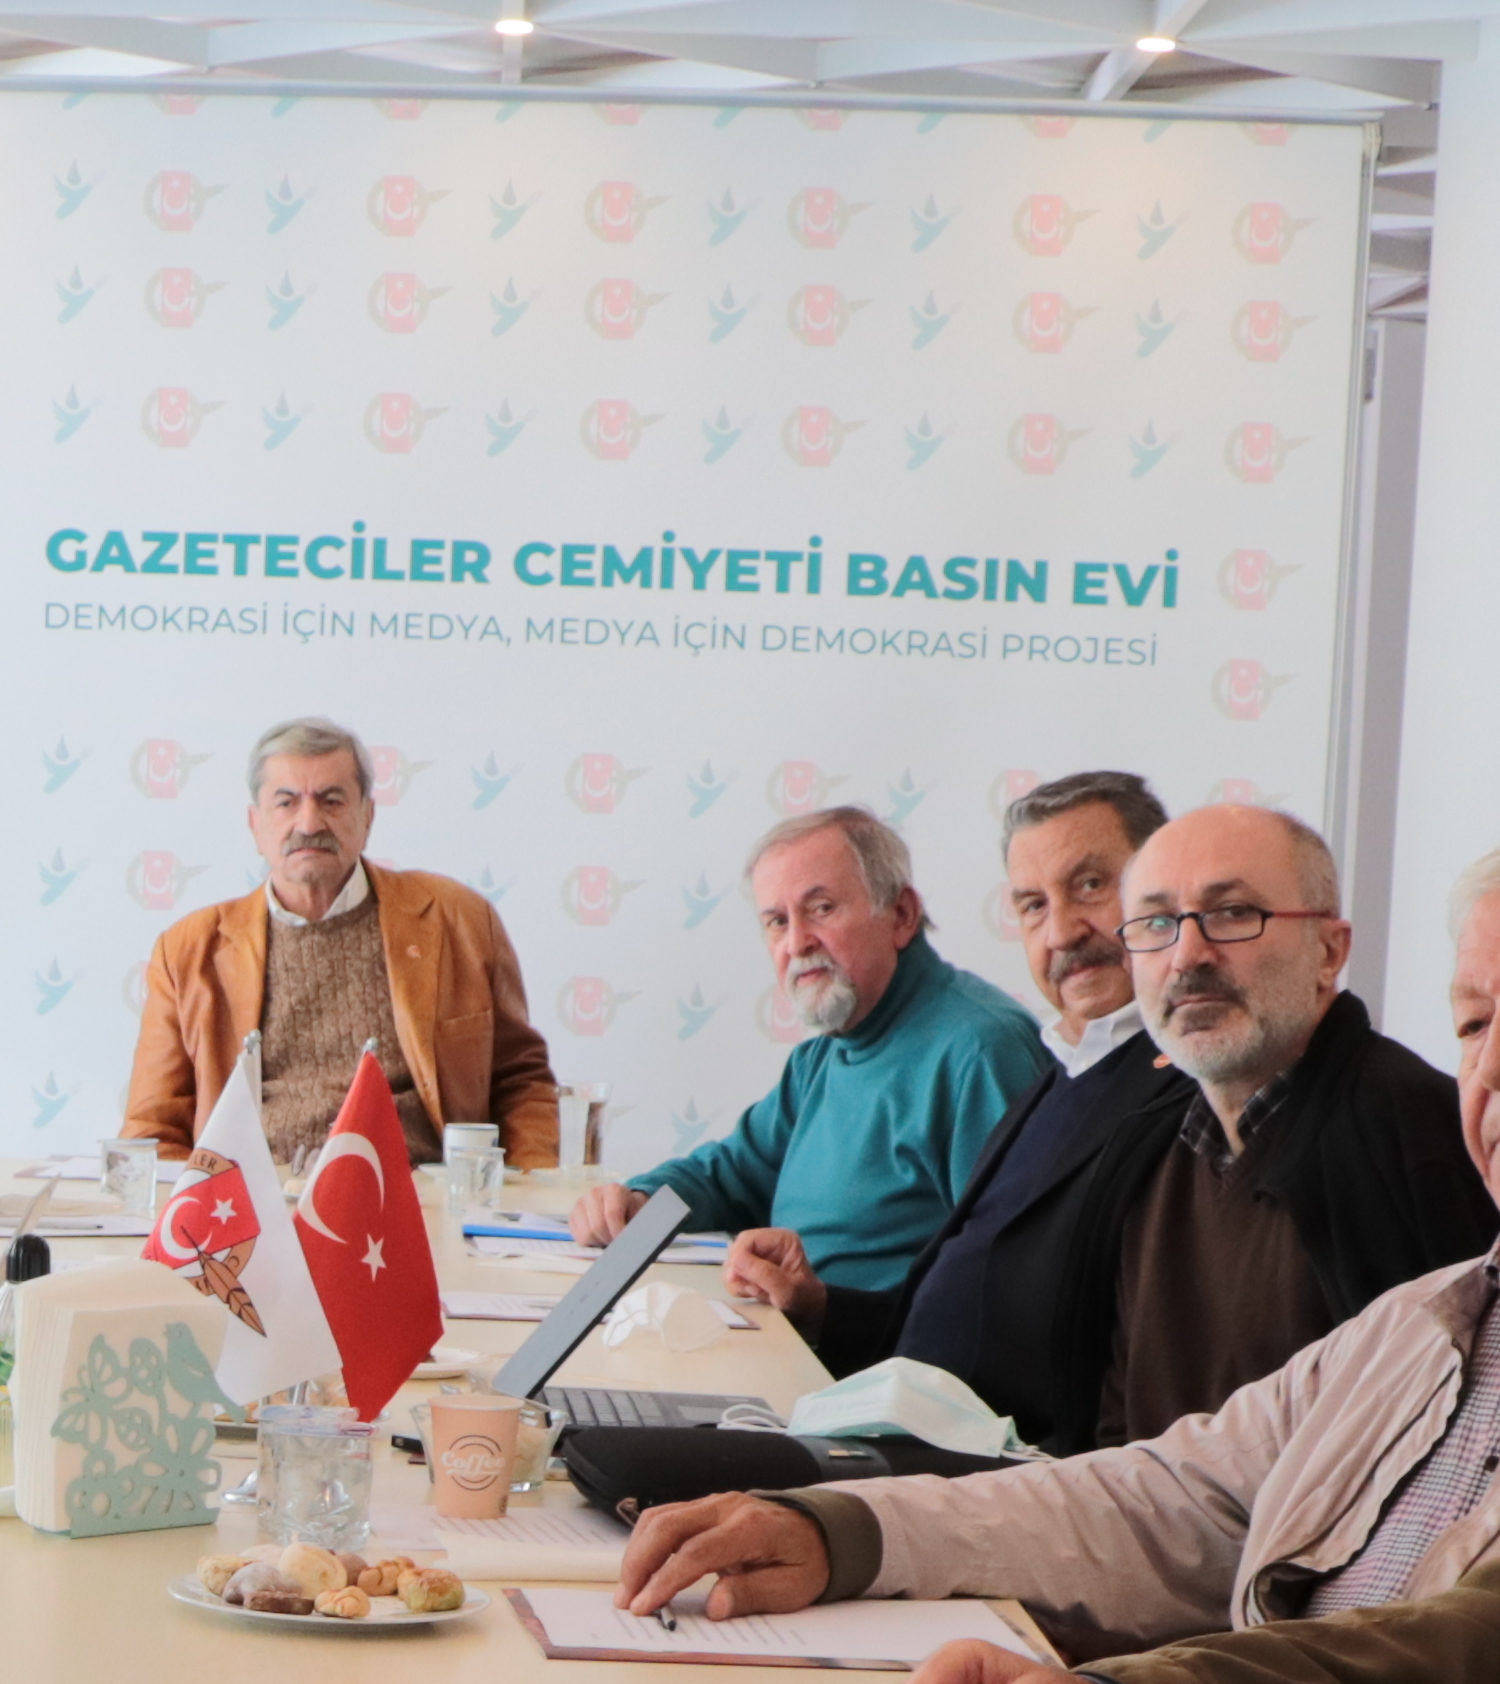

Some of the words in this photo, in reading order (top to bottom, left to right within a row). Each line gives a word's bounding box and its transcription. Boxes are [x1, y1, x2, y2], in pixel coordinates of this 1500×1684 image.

[45, 521, 492, 583] GAZETECİLER
[514, 530, 823, 595] CEMİYETİ
[847, 553, 1049, 604] BASIN
[1072, 548, 1179, 608] EVİ
[44, 602, 268, 635] DEMOKRASİ
[282, 604, 355, 644] İÇİN
[369, 612, 512, 647] MEDYA,
[526, 617, 660, 648] MEDYA
[673, 615, 747, 656] İÇİN
[761, 623, 988, 659] DEMOKRASİ
[1002, 633, 1158, 666] PROJESİ
